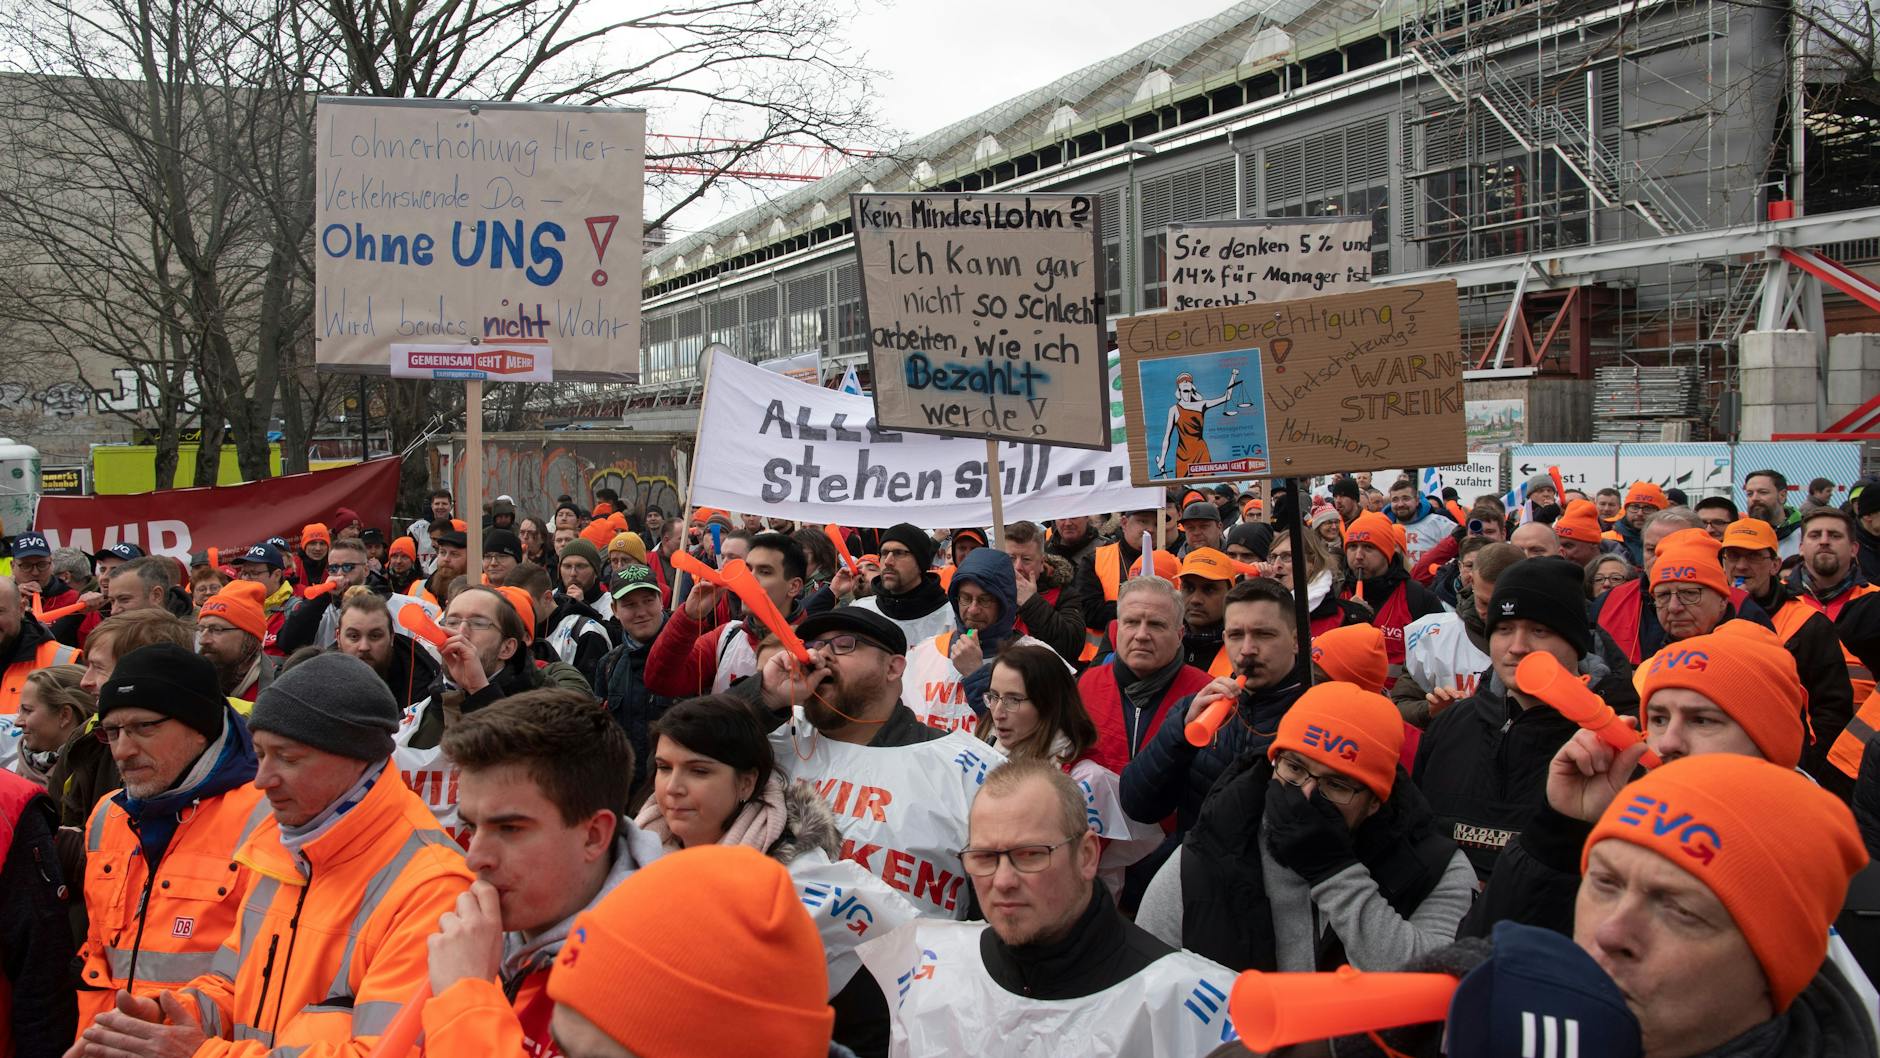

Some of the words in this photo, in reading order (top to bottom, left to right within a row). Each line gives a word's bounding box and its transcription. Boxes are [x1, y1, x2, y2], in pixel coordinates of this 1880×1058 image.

[329, 114, 538, 177] Lohnerhöhung
[480, 176, 527, 211] Da
[859, 198, 900, 229] Kein
[322, 222, 435, 266] Ohne
[451, 219, 566, 287] UNS
[1174, 234, 1211, 261] Sie
[1219, 236, 1290, 259] denken
[1342, 235, 1372, 252] und
[889, 239, 934, 275] Ich
[1033, 255, 1087, 292] gar
[1221, 264, 1258, 288] für
[1263, 265, 1341, 291] Manager
[1346, 266, 1371, 284] ist
[324, 286, 376, 338] Wird
[396, 294, 467, 337] beides
[482, 299, 550, 339] nicht
[903, 284, 966, 315] nicht
[1034, 329, 1080, 365] ich
[411, 355, 472, 367] GEMEINSAM
[477, 355, 502, 369] GEHT
[506, 354, 533, 370] MEHR!
[1340, 381, 1465, 423] STREIK!
[1231, 444, 1262, 457] EVG
[1189, 463, 1229, 474] GEMEINSAM
[1231, 462, 1247, 473] GEHT
[1579, 473, 1587, 483] 1
[1455, 478, 1492, 488] zufahrt
[1635, 494, 1655, 502] EVG
[19, 537, 46, 549] EVG
[111, 544, 131, 555] VG
[1348, 531, 1370, 541] EVG
[247, 546, 266, 557] VG
[1661, 567, 1697, 580] EVG
[1408, 623, 1442, 651] EVG
[1651, 649, 1709, 673] EVG
[1303, 725, 1360, 762] EVG
[1619, 795, 1723, 866] EVG
[801, 881, 874, 937] EVG
[175, 920, 191, 934] DB
